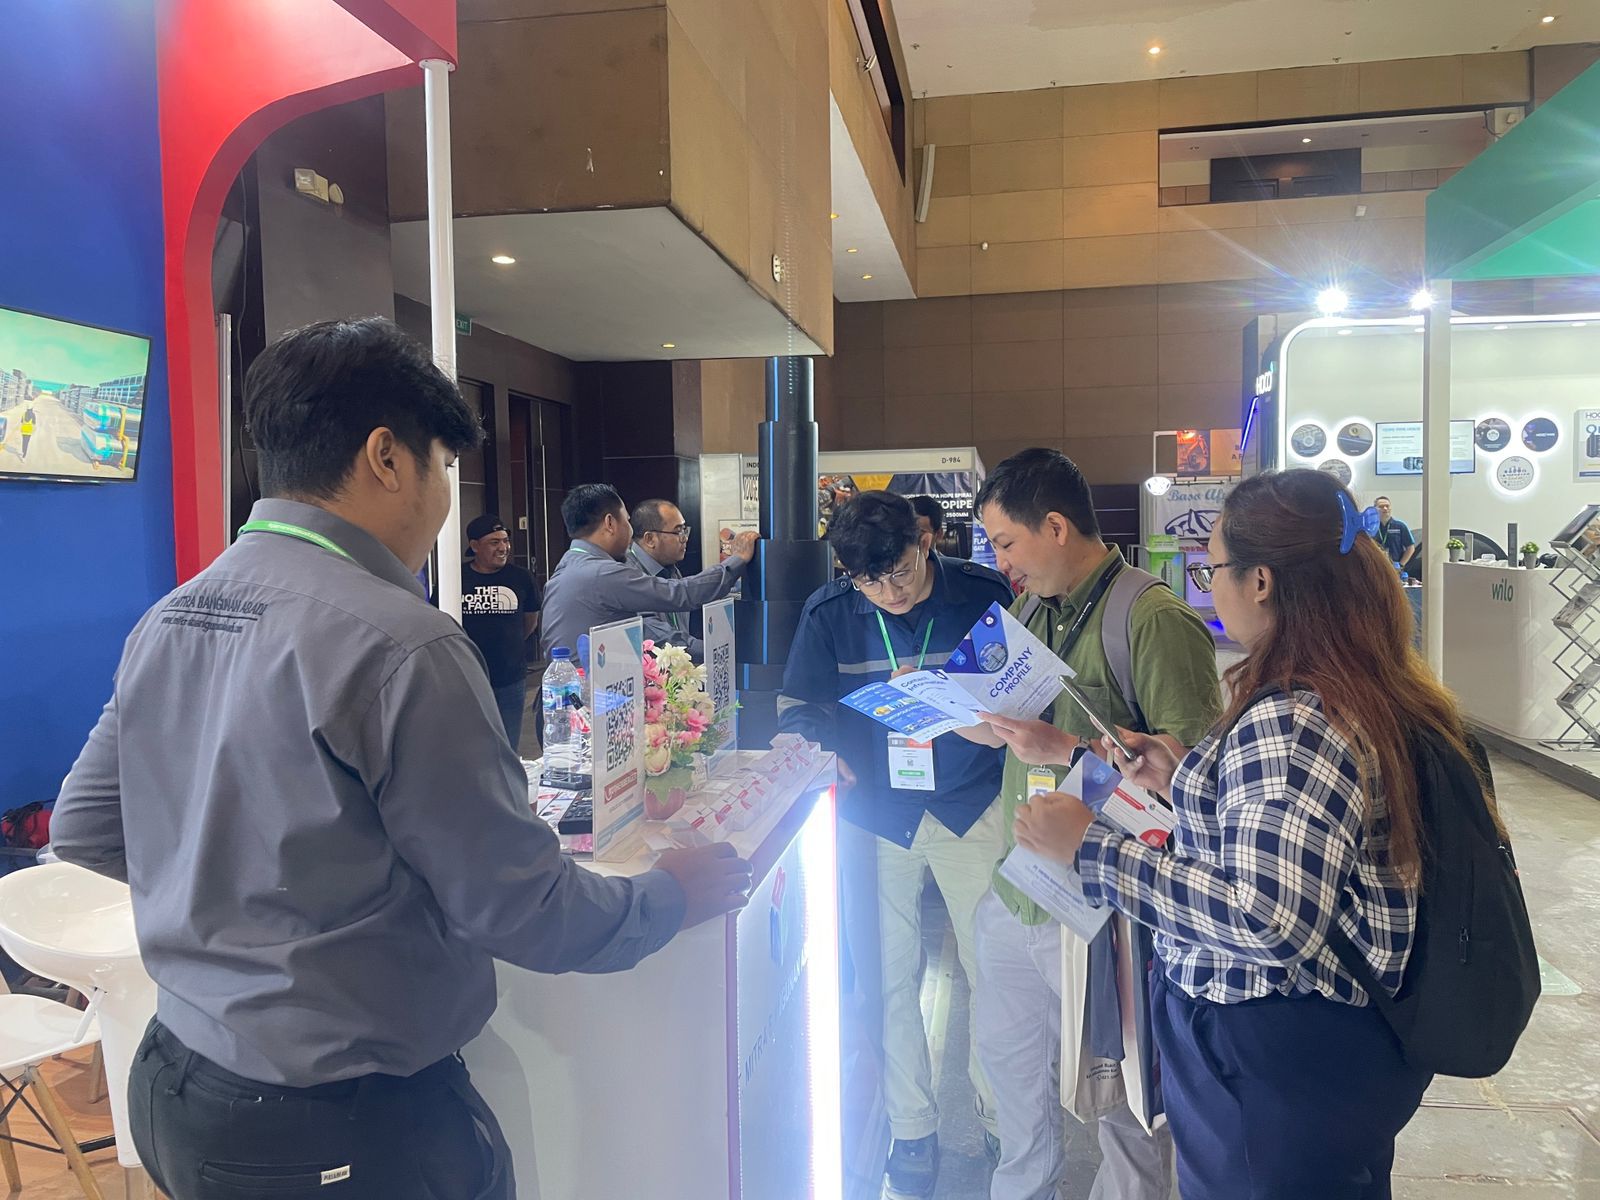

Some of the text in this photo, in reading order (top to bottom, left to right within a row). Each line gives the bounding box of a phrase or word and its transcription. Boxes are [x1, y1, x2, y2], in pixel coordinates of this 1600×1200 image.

[937, 499, 973, 510] OPIPE
[974, 537, 988, 545] FLAP
[474, 586, 498, 595] THE
[1492, 578, 1513, 602] wilo
[468, 602, 498, 610] FACE
[990, 646, 1033, 698] COMPANY
[1004, 663, 1033, 694] PROFILE
